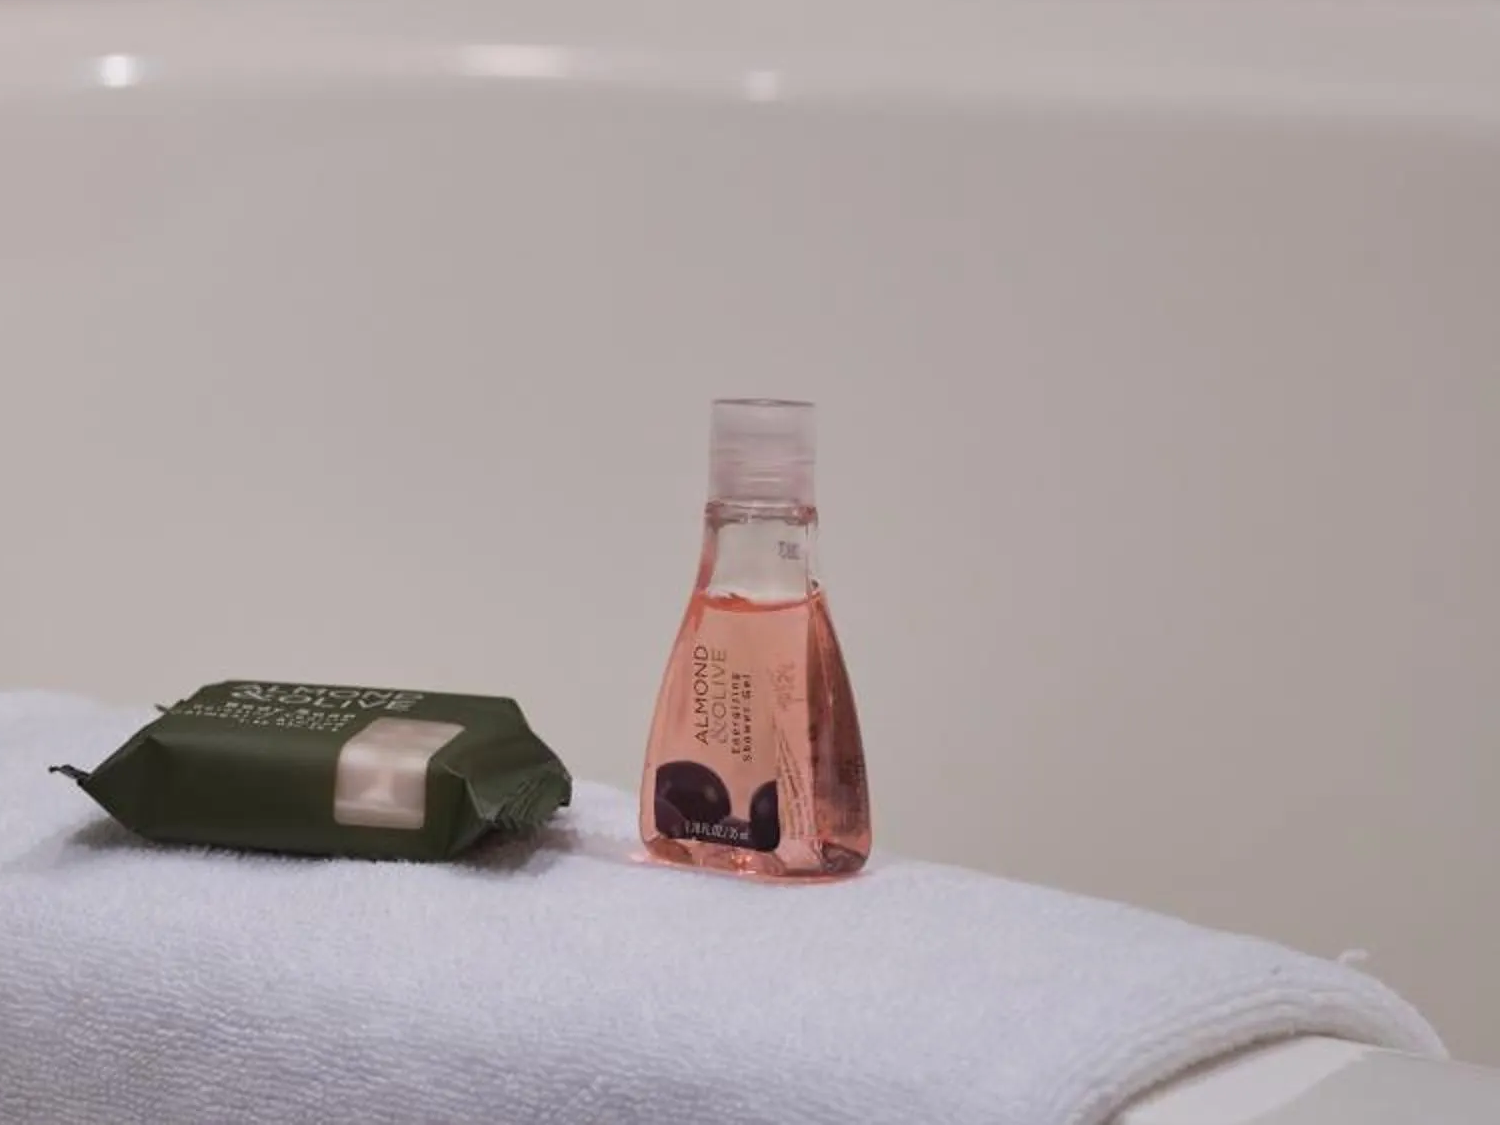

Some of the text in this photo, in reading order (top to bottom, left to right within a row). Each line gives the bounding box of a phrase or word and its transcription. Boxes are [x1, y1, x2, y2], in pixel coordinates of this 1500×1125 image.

[693, 645, 708, 746] ALMOND
[742, 674, 752, 763] Shower Gel
